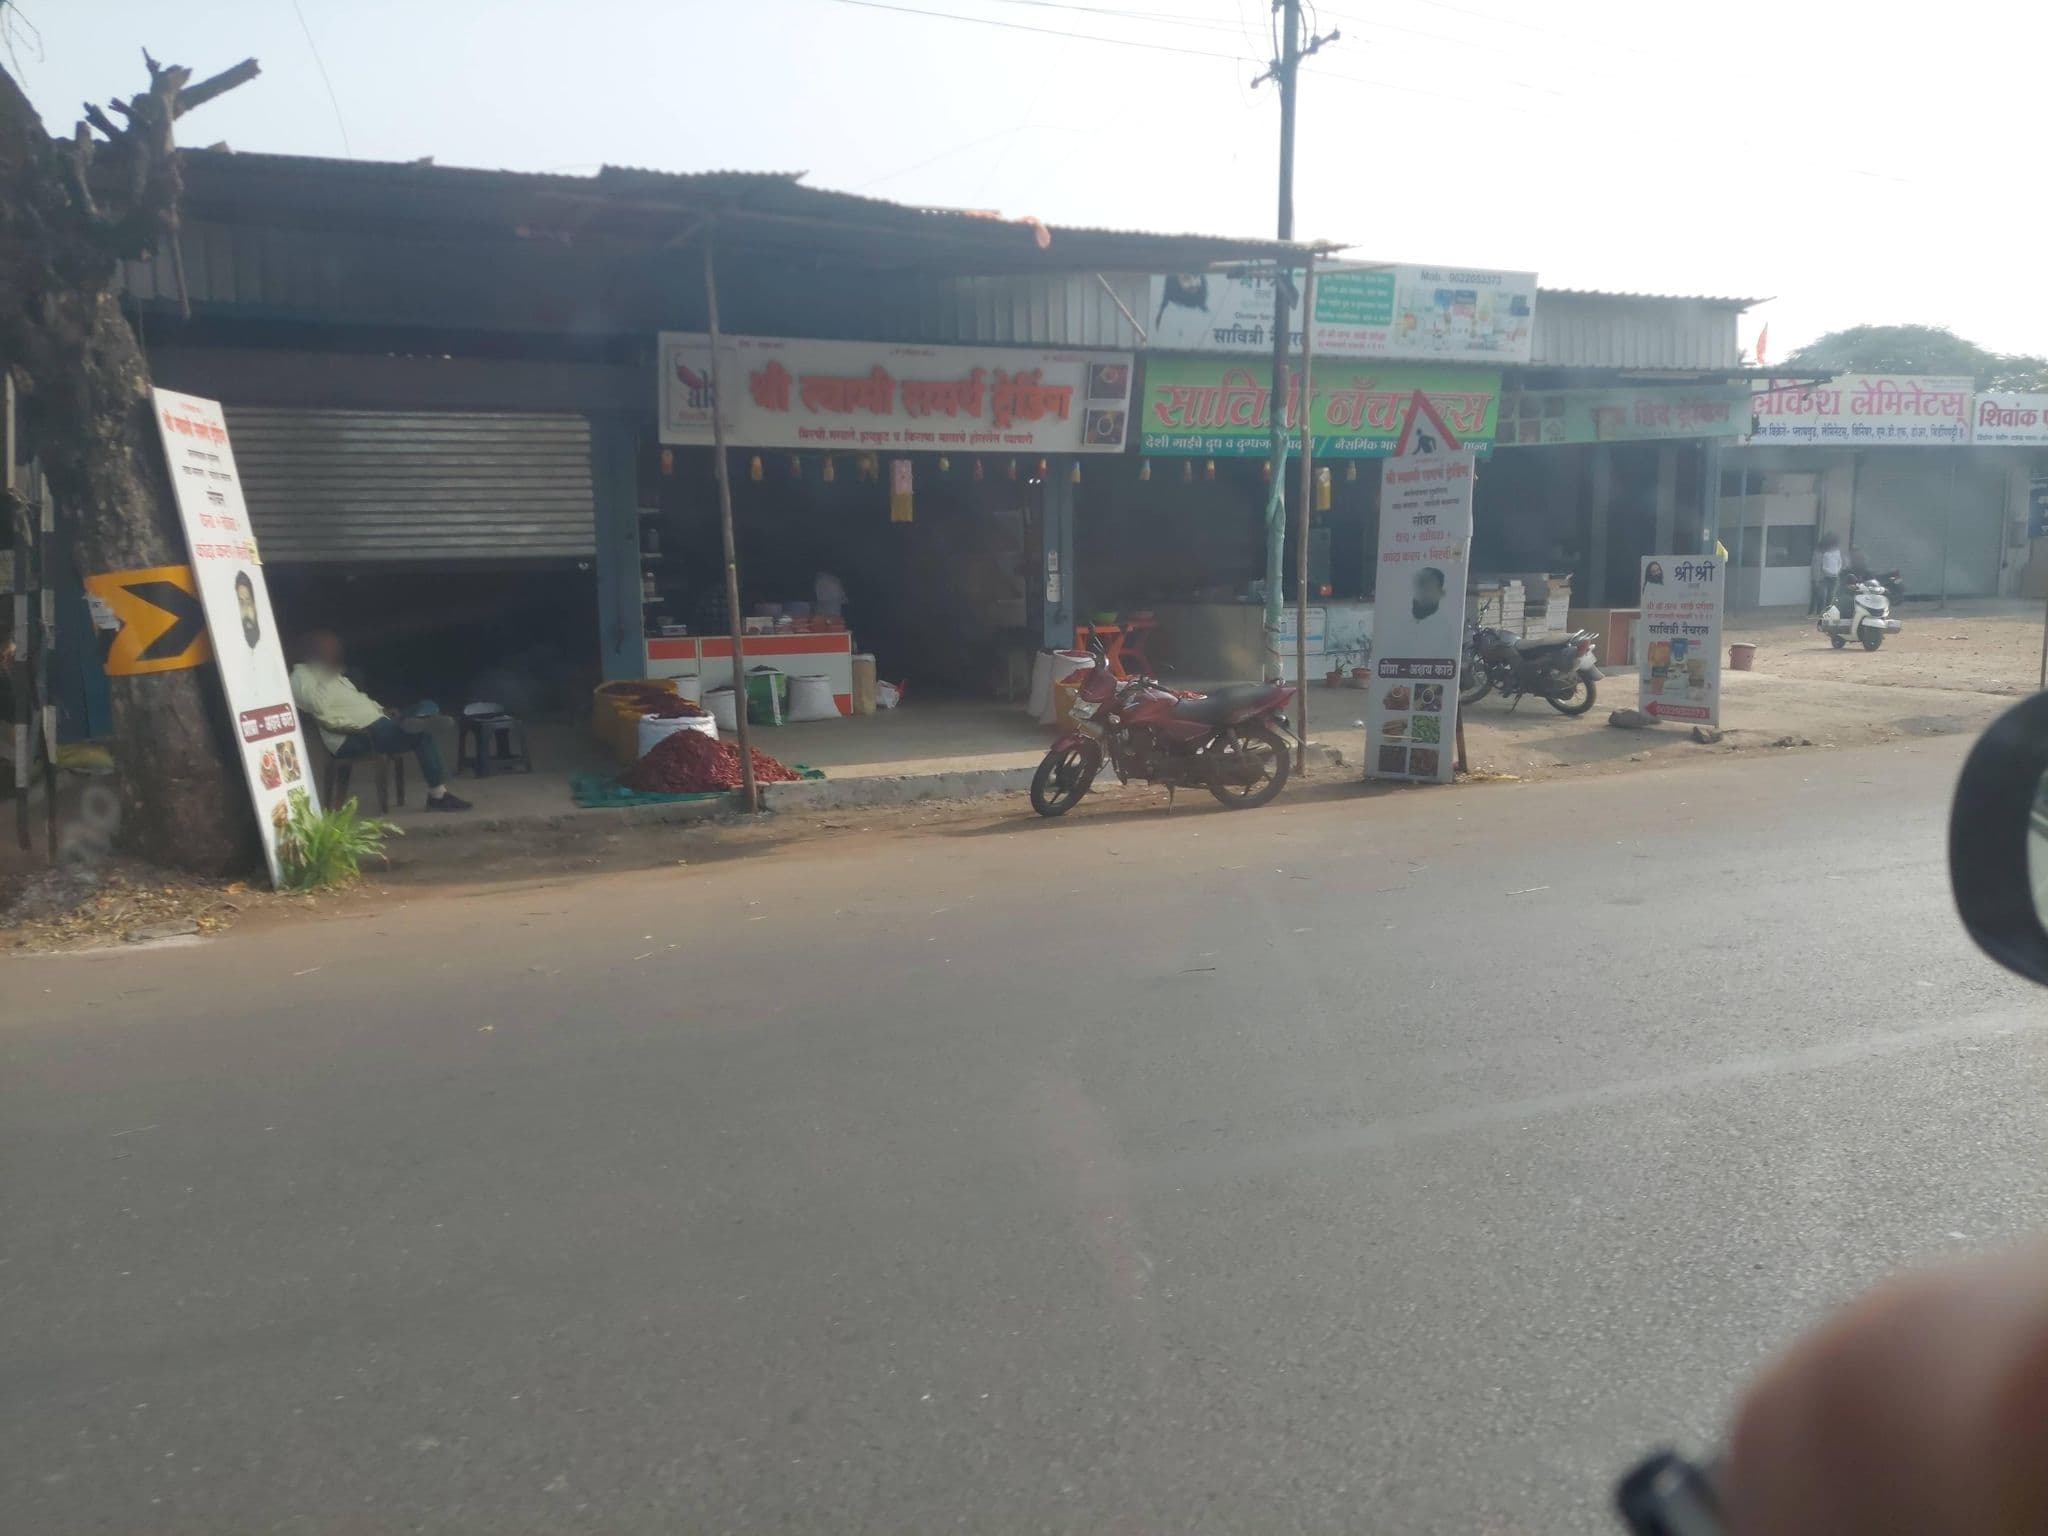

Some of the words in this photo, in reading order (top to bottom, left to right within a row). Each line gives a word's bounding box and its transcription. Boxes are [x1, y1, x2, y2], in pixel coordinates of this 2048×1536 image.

[1213, 323, 1264, 345] सावित्री
[1979, 400, 2039, 427] शिवांक
[1648, 621, 1679, 635] सावित्री
